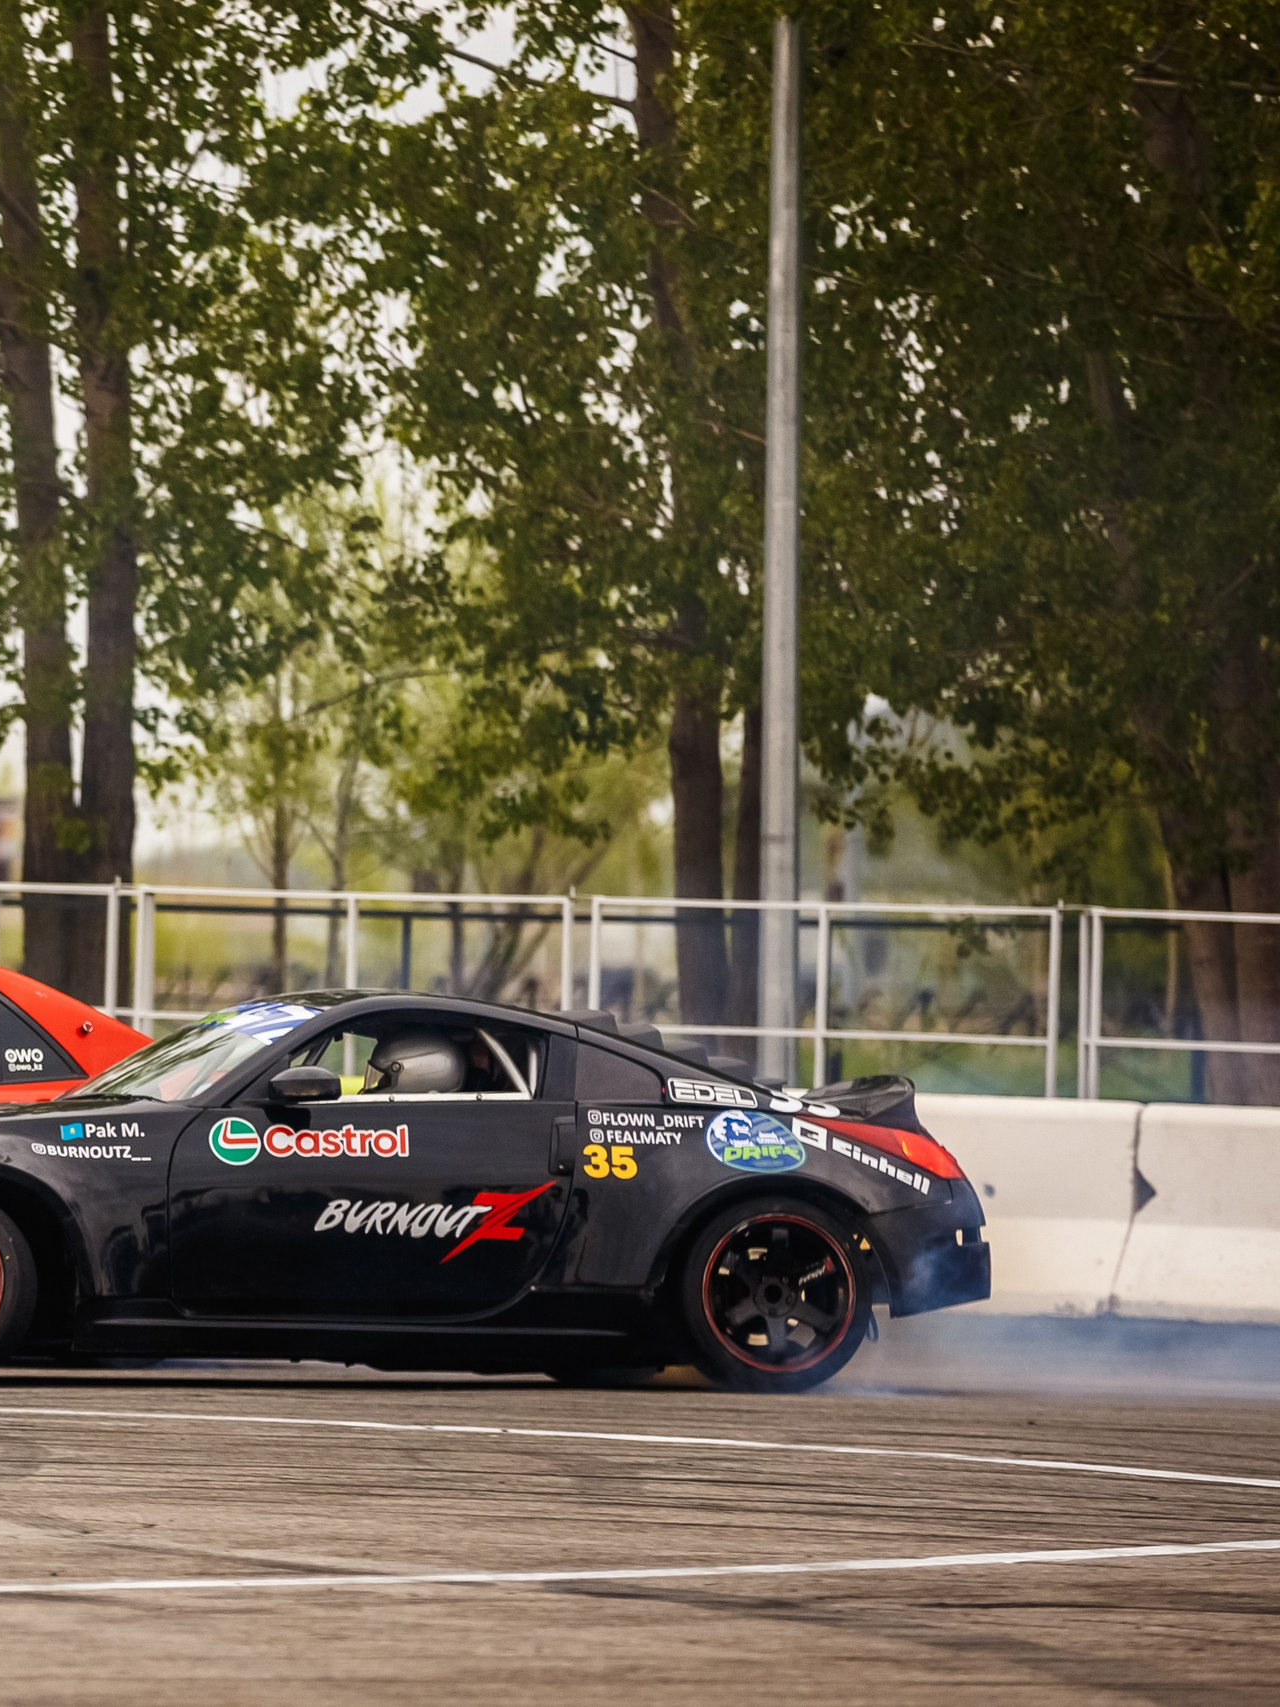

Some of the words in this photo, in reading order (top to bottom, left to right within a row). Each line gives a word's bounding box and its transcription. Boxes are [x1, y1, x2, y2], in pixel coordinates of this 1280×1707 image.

[4, 1047, 44, 1063] OWO
[673, 1081, 755, 1105] EDEL
[84, 1122, 117, 1138] Pak
[121, 1122, 145, 1137] M.
[264, 1124, 409, 1157] Castrol
[583, 1144, 638, 1180] 35
